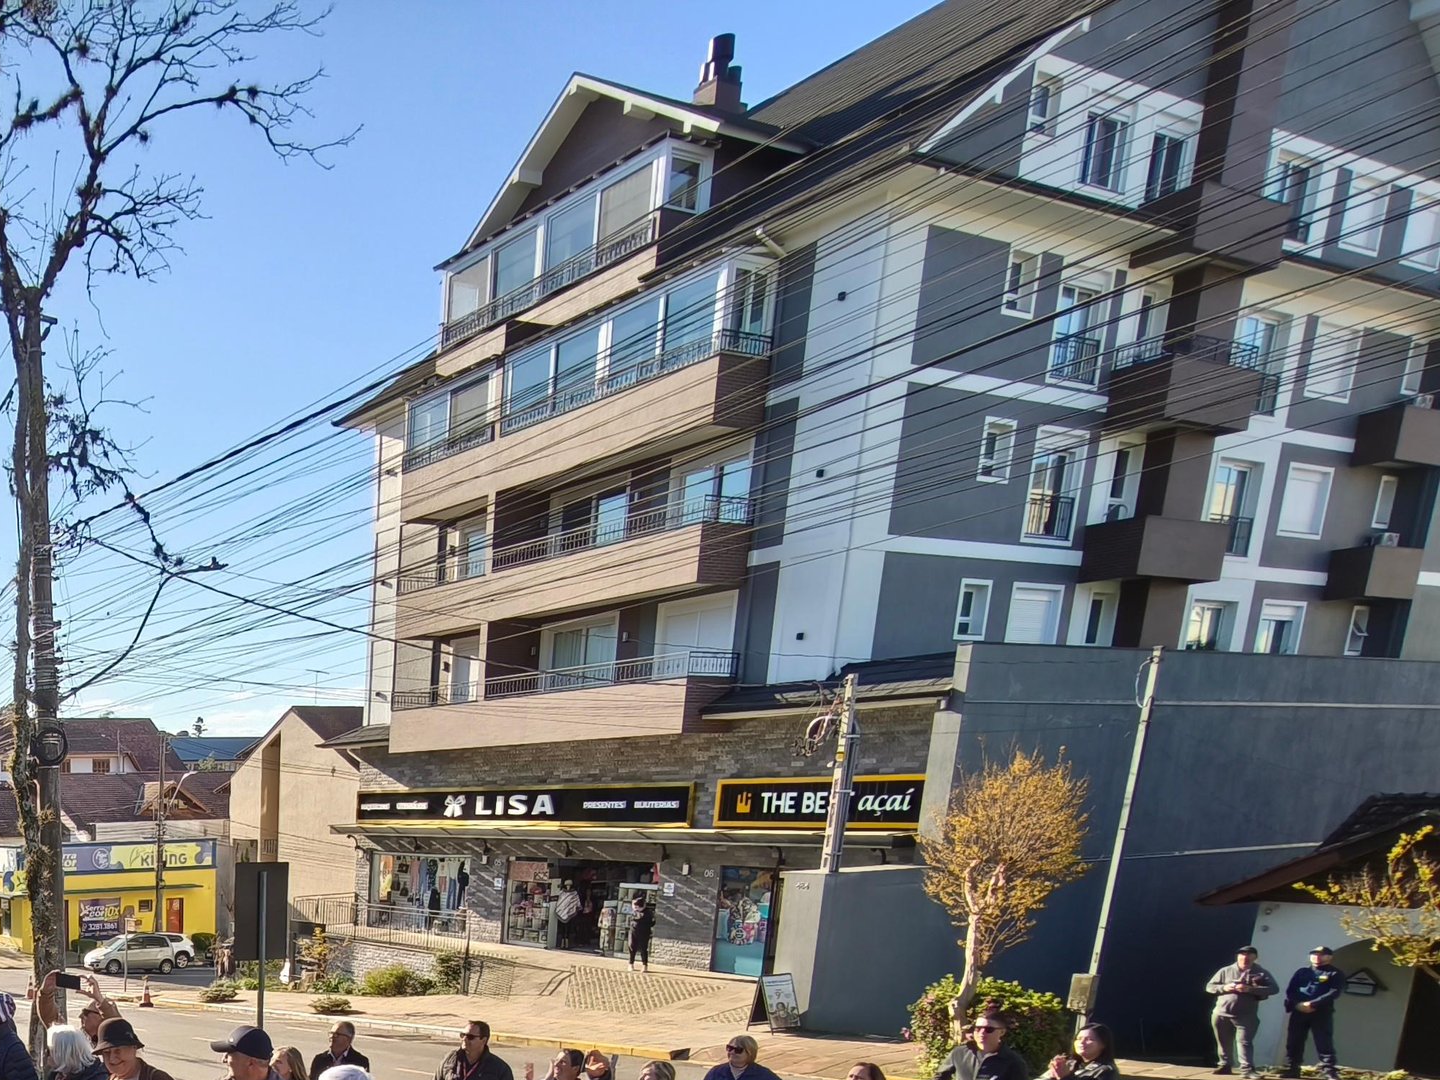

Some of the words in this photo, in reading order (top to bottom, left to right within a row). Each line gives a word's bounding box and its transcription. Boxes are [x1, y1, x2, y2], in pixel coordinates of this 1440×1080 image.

[475, 794, 555, 816] LISA
[583, 801, 626, 809] PRESENTES
[761, 792, 796, 814] THE
[858, 788, 915, 816] açaí
[704, 869, 714, 878] 06
